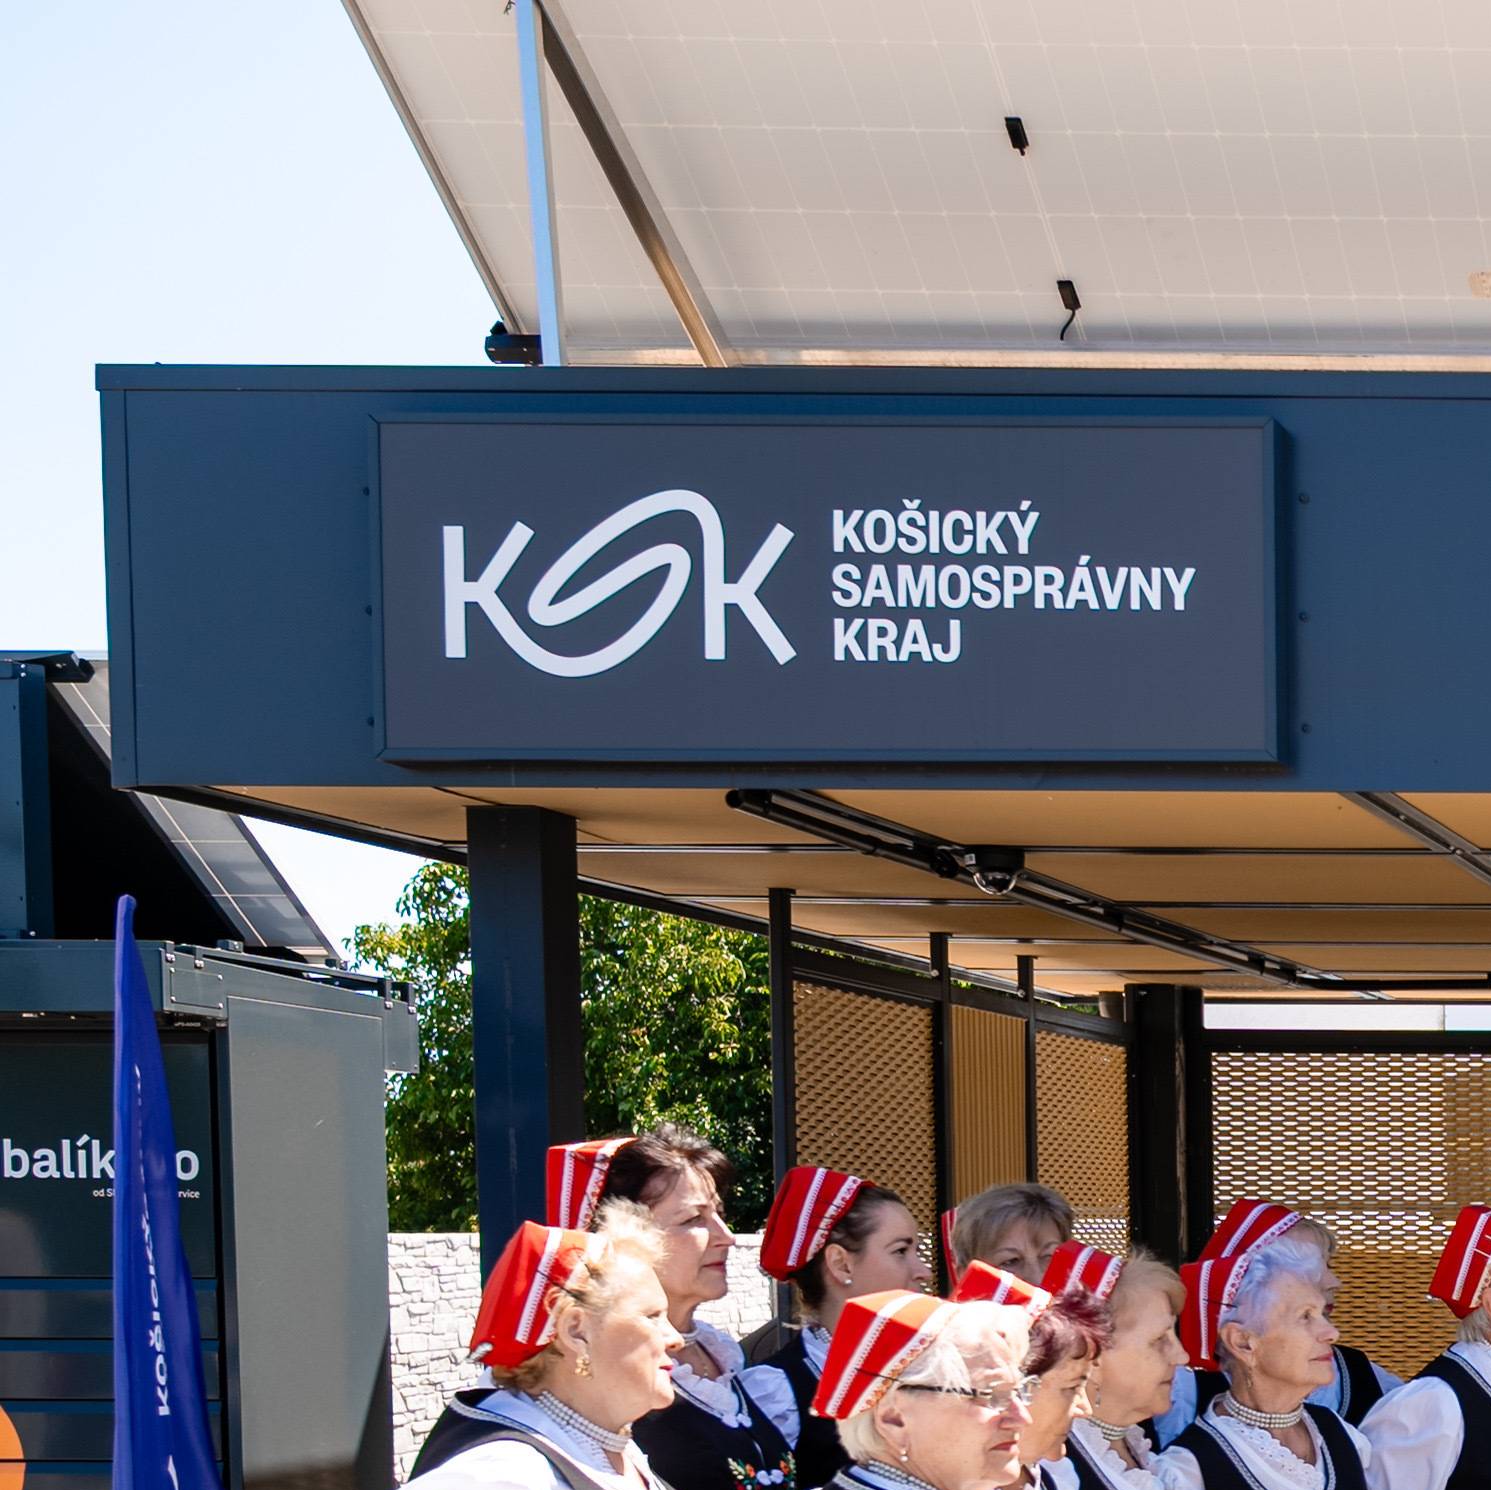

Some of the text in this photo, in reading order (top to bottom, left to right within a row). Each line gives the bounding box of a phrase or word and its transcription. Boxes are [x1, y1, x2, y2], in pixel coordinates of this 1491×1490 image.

[832, 499, 1040, 555] KOŠICKÝ
[443, 489, 797, 678] KSK
[831, 555, 1197, 612] SAMOSPRÁVNY
[832, 617, 962, 663] KRAJ
[3, 1134, 200, 1181] balíko
[178, 1188, 200, 1199] rvice
